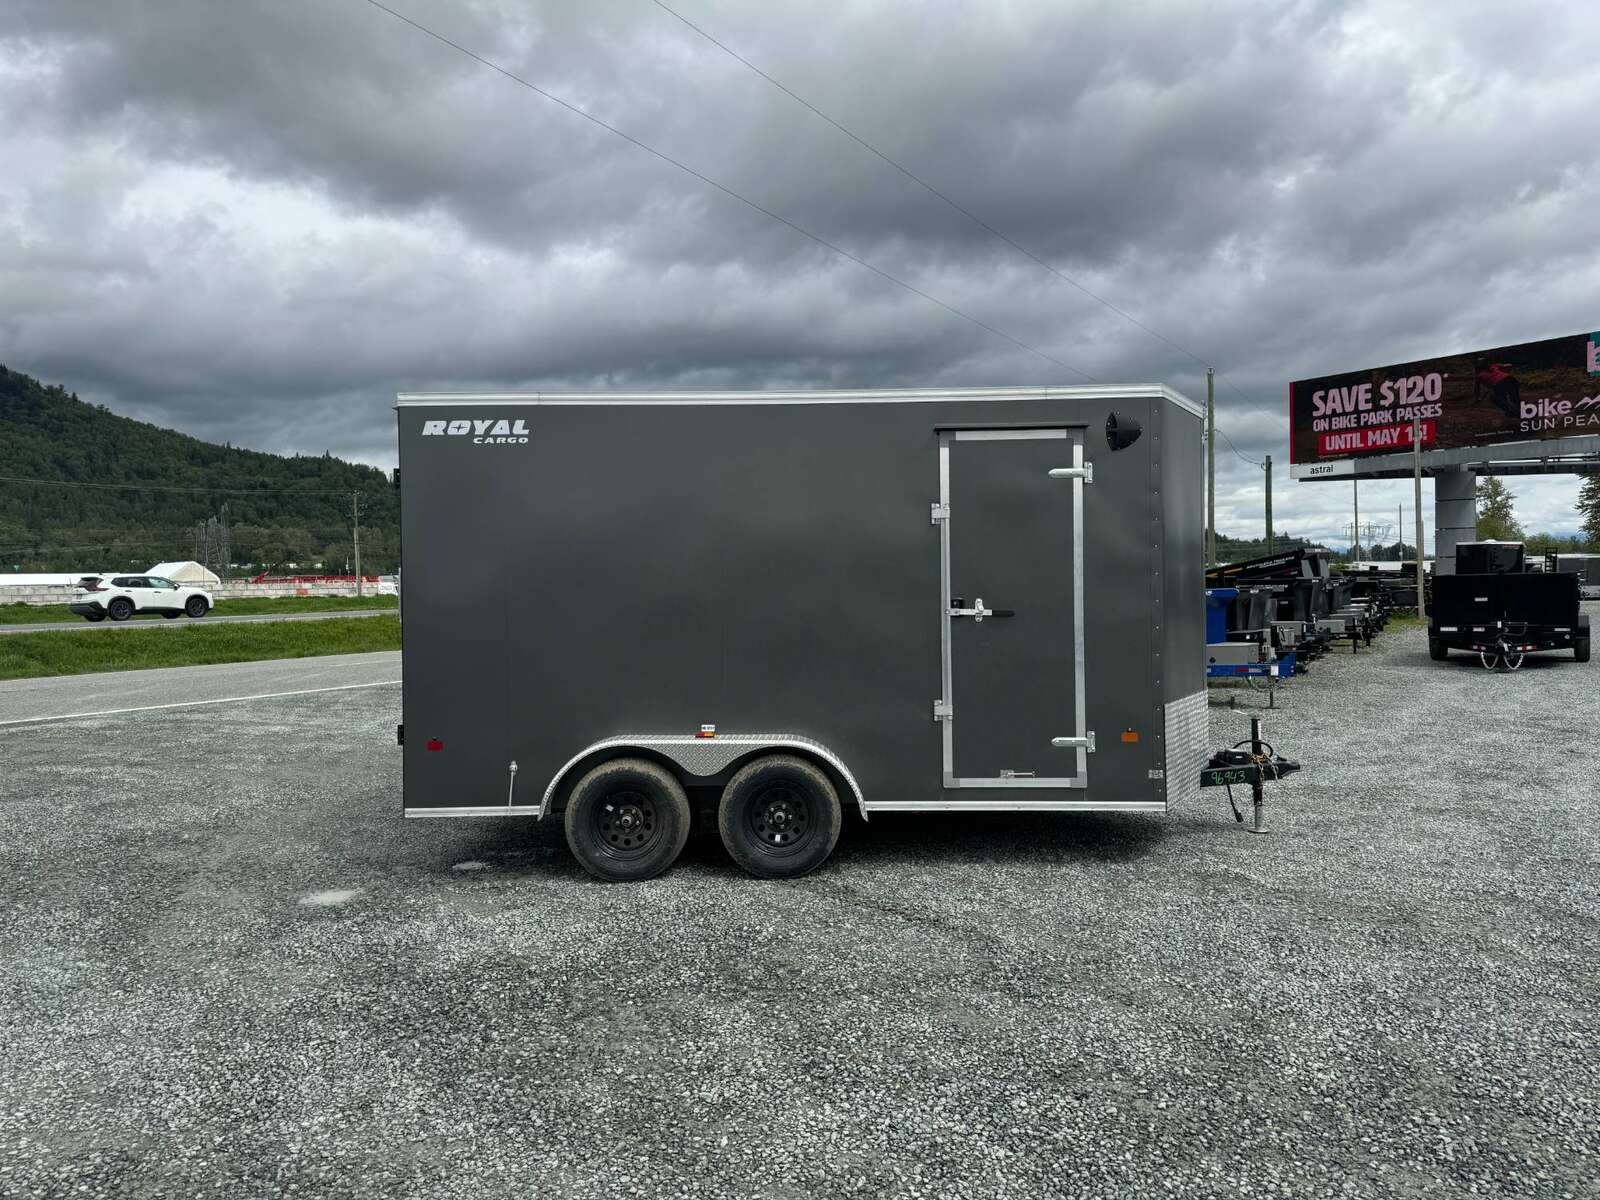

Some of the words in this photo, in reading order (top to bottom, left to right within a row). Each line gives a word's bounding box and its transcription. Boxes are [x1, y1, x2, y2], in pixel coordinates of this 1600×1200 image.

[1312, 383, 1373, 416] SAVE
[1520, 398, 1572, 419] bike
[422, 420, 530, 436] ROYAL
[1313, 418, 1329, 432] ON
[1332, 414, 1358, 429] BIKE
[1360, 409, 1393, 426] PARK
[1396, 403, 1443, 421] PASSES
[1520, 418, 1555, 432] SUN
[1564, 413, 1600, 428] PEA
[1325, 433, 1364, 451] UNTIL
[1368, 427, 1401, 446] MAY
[1310, 464, 1334, 474] astral
